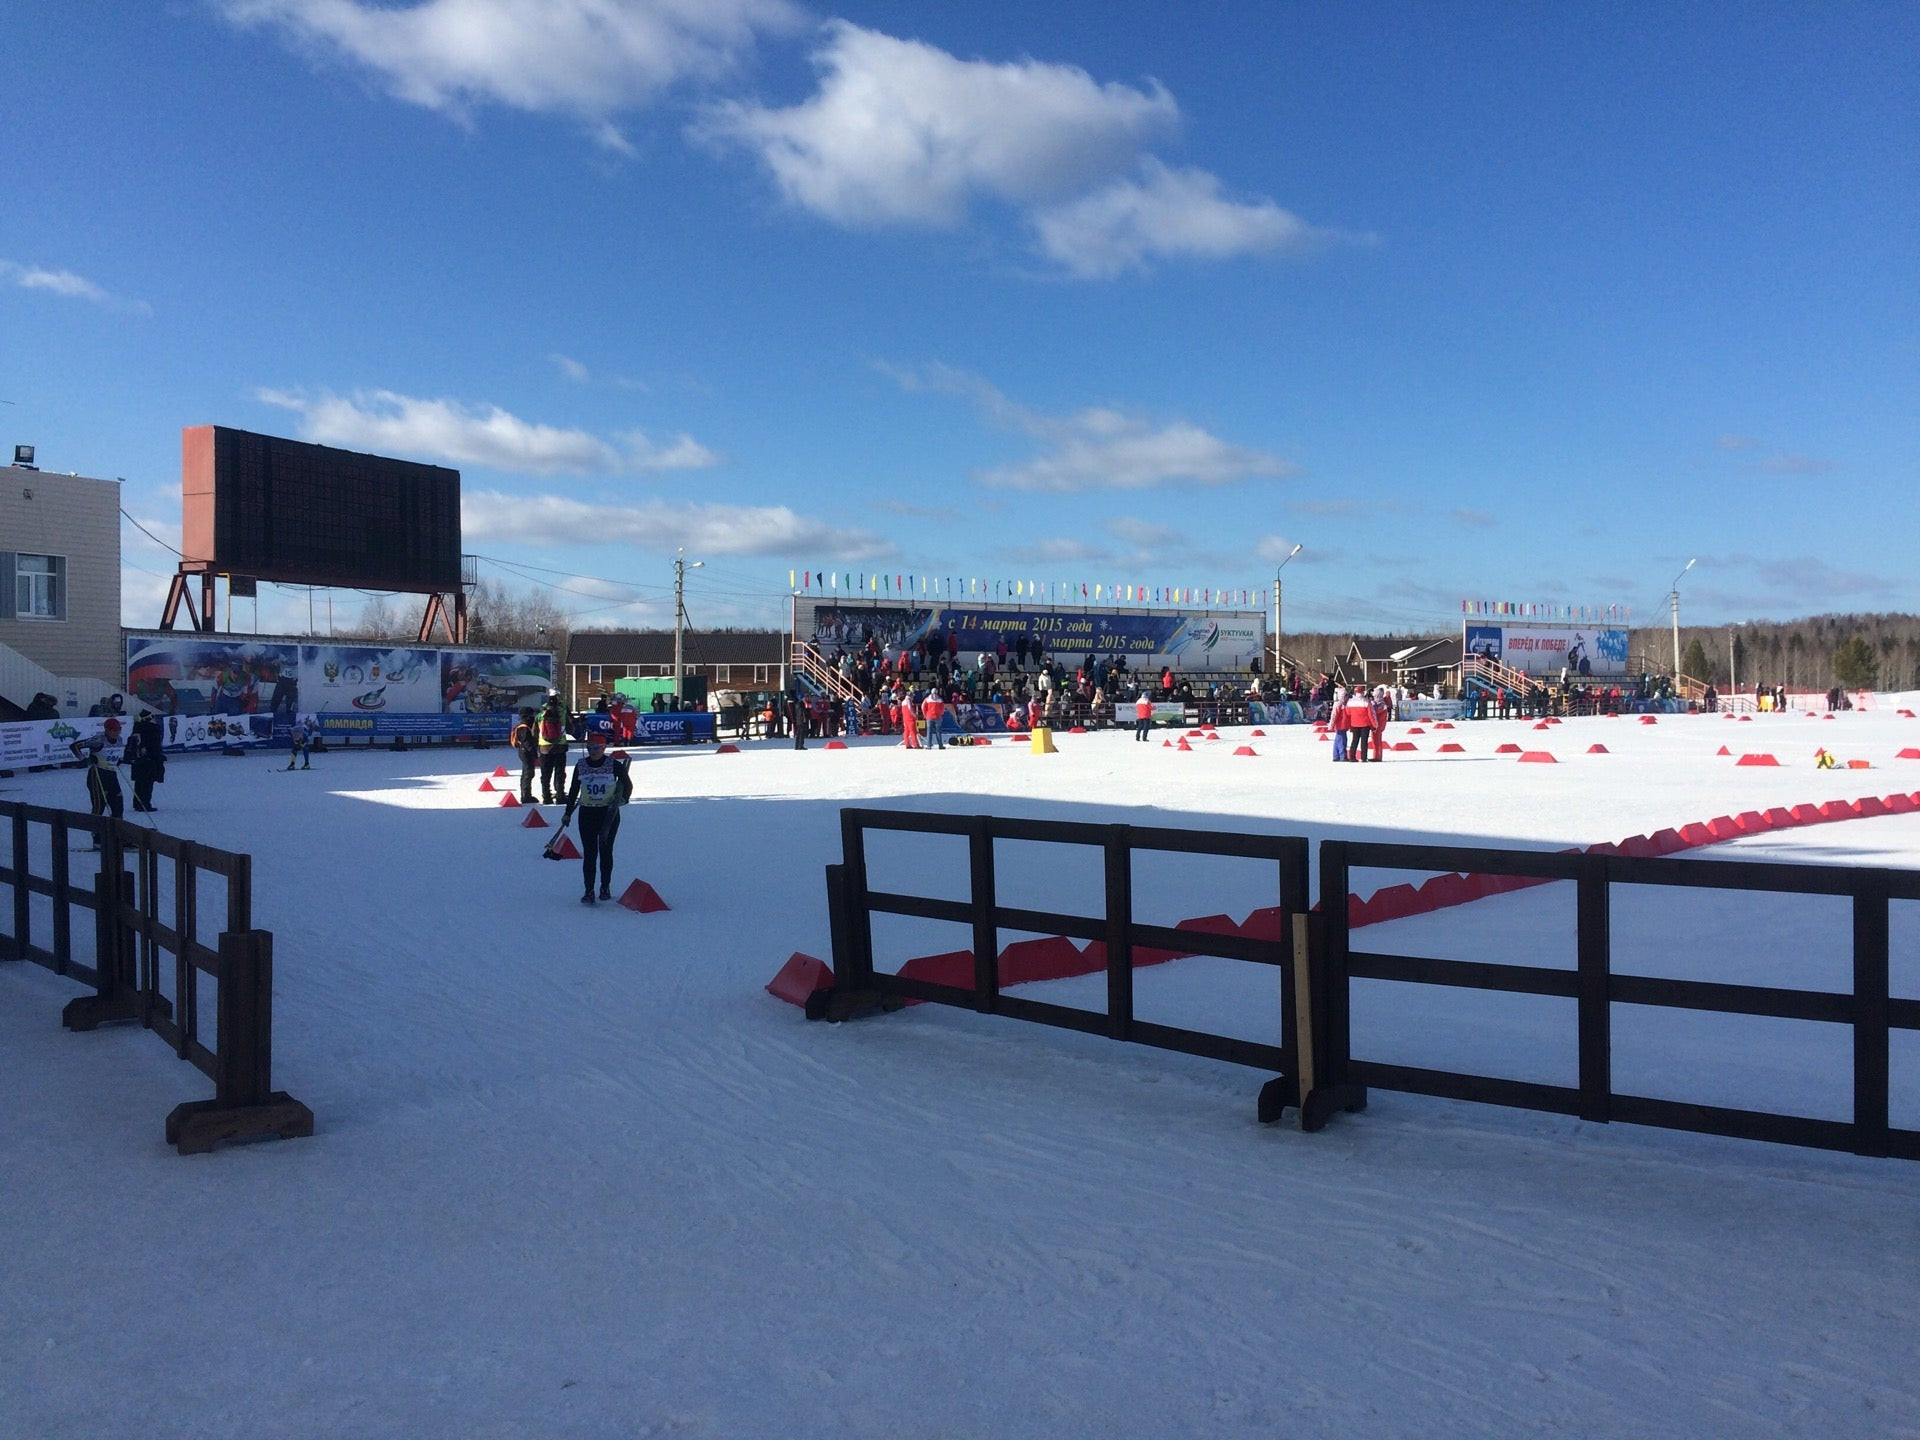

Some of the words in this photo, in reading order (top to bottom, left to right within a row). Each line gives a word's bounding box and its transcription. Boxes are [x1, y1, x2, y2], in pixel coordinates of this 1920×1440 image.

[948, 618, 956, 629] с
[961, 615, 977, 630] 14
[980, 619, 1027, 633] марта
[1032, 617, 1063, 631] 2015
[1066, 618, 1093, 633] года
[1049, 636, 1094, 650] марта
[1097, 634, 1127, 649] 2015
[1130, 636, 1155, 650] года
[1508, 636, 1534, 653] ВПЕРЁД
[1534, 638, 1541, 651] К
[1541, 638, 1566, 653] ПОБЕДЕ
[645, 720, 685, 731] СЕРВИС
[586, 783, 606, 795] 504
